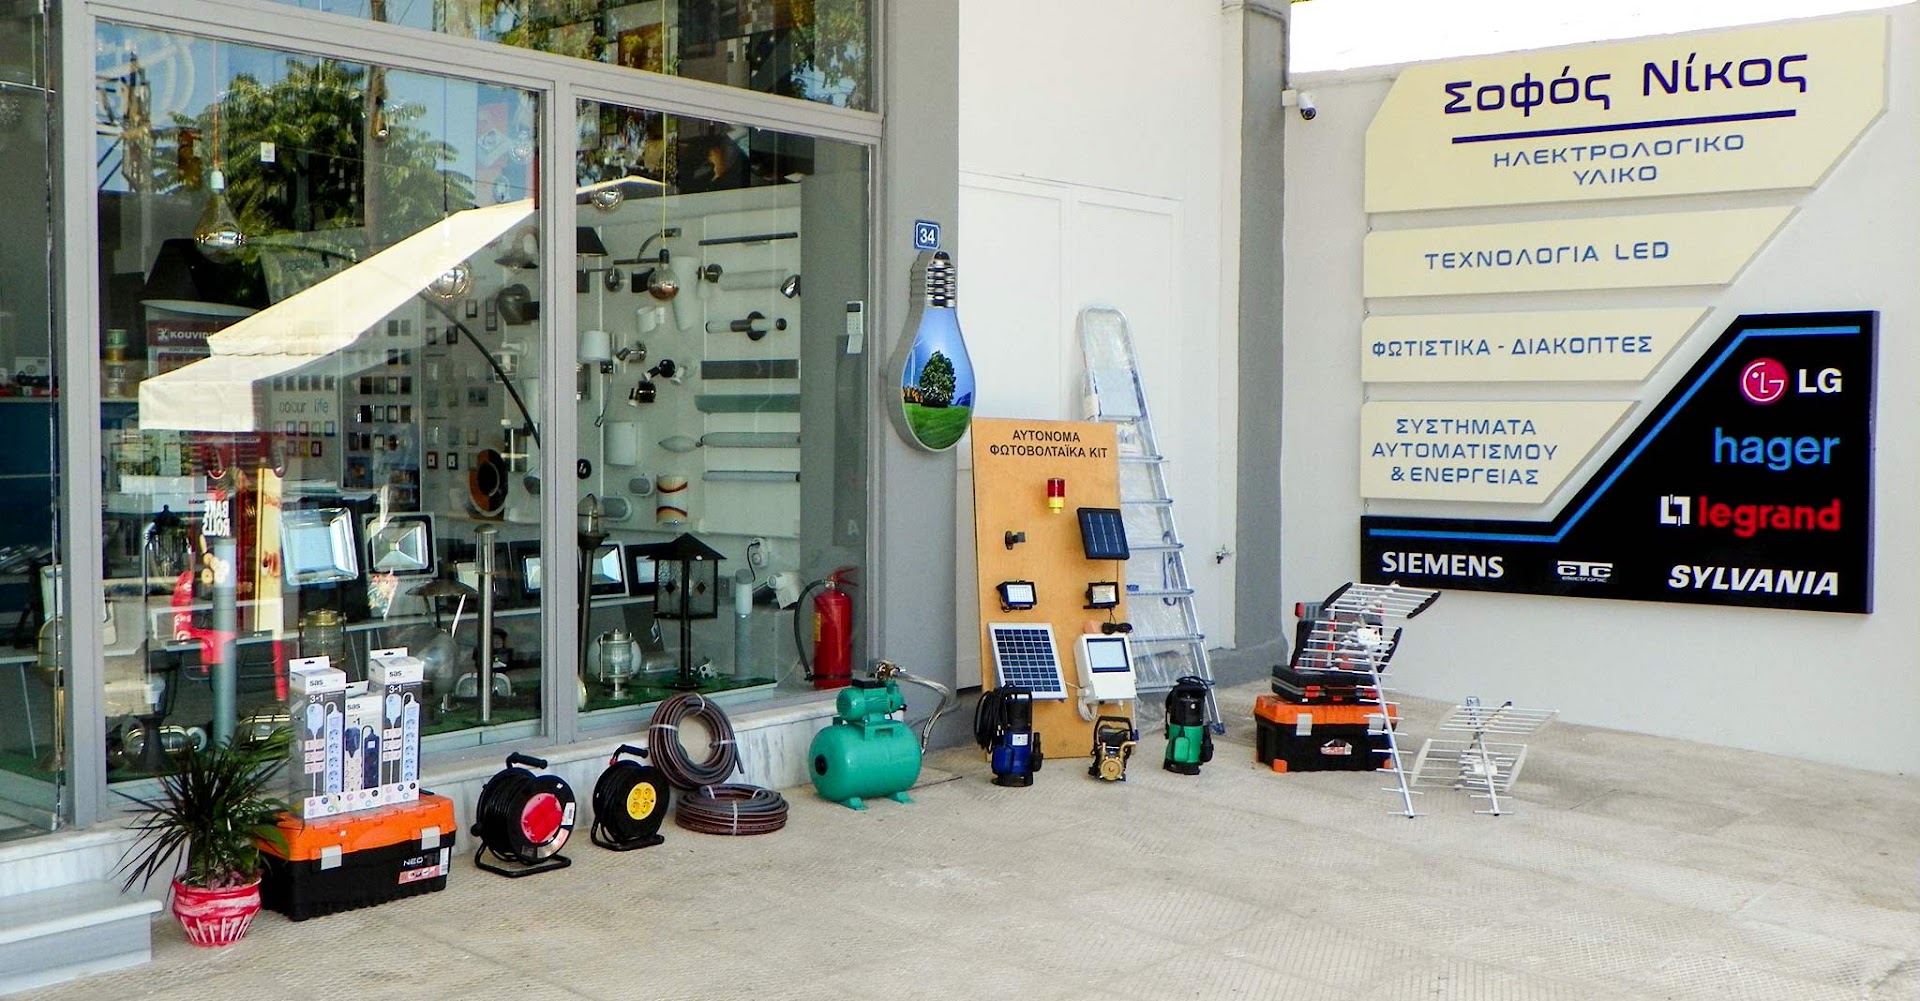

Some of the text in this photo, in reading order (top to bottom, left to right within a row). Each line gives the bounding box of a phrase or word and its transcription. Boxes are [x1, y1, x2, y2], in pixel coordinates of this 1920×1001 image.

[1444, 52, 1808, 118] Σοφός Νίκος
[1493, 134, 1745, 168] ΗΛΕΚΤΡΟΛΟΓΙΚΟ
[1572, 165, 1658, 186] ΥΛΙΚΟ
[920, 227, 936, 245] 34
[1424, 241, 1670, 270] ΤΕΧΝΟΛΟΓΙΑ LED
[170, 331, 214, 340] KOUVID
[1371, 338, 1492, 358] ΦΩΤΙΣΤΙΚΑ
[1510, 336, 1653, 356] ΔΙΑΚΟΠΤΕΣ
[1798, 367, 1843, 394] LG
[1012, 429, 1081, 443] ΑΥΤΟΝΟΜΑ
[1395, 418, 1537, 437] ΣΥΣΤΗΜΑΤΑ
[989, 444, 1108, 458] ΦΩΤΟΒΟΛΤΑΪΚΑ KIT
[1371, 441, 1559, 461] ΑΥΤΟΜΑΤΙΣΜΟΥ
[1714, 427, 1840, 471] hager
[1390, 466, 1540, 486] & ΕΝΕΡΓΕΙΑΣ
[1698, 496, 1841, 538] legrand
[1382, 551, 1504, 579] SIEMENS
[1668, 564, 1839, 596] SYLVANIA
